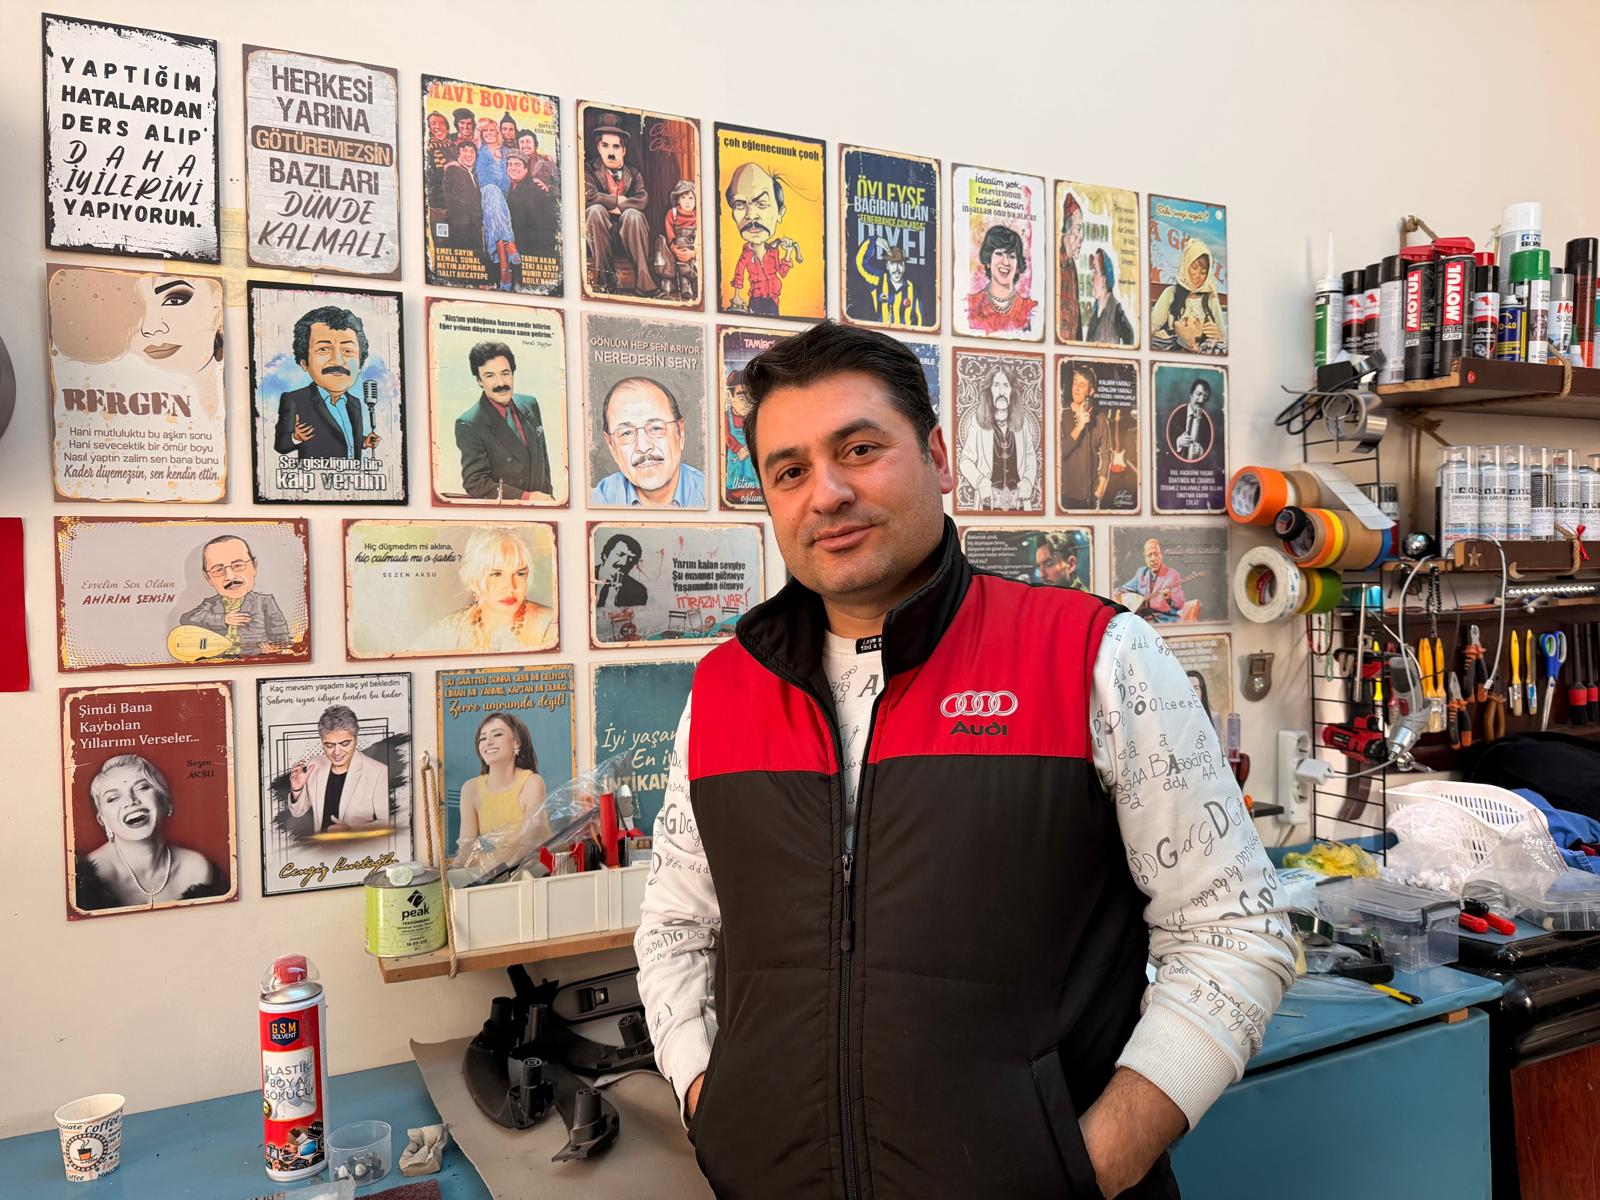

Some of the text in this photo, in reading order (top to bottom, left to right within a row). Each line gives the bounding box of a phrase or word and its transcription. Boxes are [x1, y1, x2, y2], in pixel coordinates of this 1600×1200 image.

[61, 56, 200, 92] YAPTIĞIM
[271, 65, 373, 105] HERKESİ
[62, 85, 202, 120] HATALARDAN
[275, 96, 370, 133] YARINA
[62, 114, 201, 146] DERS ALIP
[255, 128, 391, 165] GÖTÜREMEZSİN
[724, 137, 740, 148] çoh
[798, 149, 819, 161] çooh
[270, 158, 379, 195] BAZILARI
[64, 199, 202, 228] YAPIYORUM.
[277, 190, 376, 225] DÜNDE
[854, 196, 929, 222] BAĞIRIN ULAN
[1406, 273, 1419, 328] MOTUL
[1446, 264, 1461, 322] MOTUL
[498, 318, 516, 327] hasret
[517, 321, 532, 329] nedir
[631, 340, 650, 351] HEP
[650, 341, 670, 353] SENİ
[671, 344, 701, 355] ARIYOR
[595, 350, 699, 370] NEREDESİN SEN?
[62, 388, 192, 417] BERGEN
[69, 427, 212, 441] Hani mutluluktu bu aşkın sonu
[69, 439, 213, 455] Hani sevecektik bir ömür boyu
[64, 452, 219, 465] Nasıl yaptın zalim sen bana bunu
[364, 457, 383, 471] bir
[64, 464, 220, 484] Kader diyemezsin, sen kendin ettin.
[276, 467, 387, 492] kalp verdim
[364, 543, 377, 552] Hiç
[378, 543, 418, 552] düşmedim
[698, 559, 719, 570] kalan
[124, 580, 141, 589] Sen
[145, 579, 175, 589] Oldun
[136, 592, 176, 604] SENSİN
[269, 685, 284, 693] Kaç
[286, 683, 313, 691] mevsim
[315, 683, 344, 692] yaşadım
[359, 681, 368, 689] yıl
[342, 692, 367, 700] benden
[369, 691, 379, 699] bu
[78, 702, 153, 718] Şimdi Bana
[80, 719, 141, 735] Kaybolan
[950, 720, 1008, 736] Audi
[80, 733, 200, 749] Yıllarımı Verseler...
[600, 722, 627, 752] İyi
[632, 748, 656, 769] En
[279, 862, 329, 887] Cengiz
[402, 902, 430, 921] peak
[271, 1022, 297, 1034] GSM
[271, 1032, 297, 1040] SOLVENT
[270, 1077, 306, 1089] BOYA
